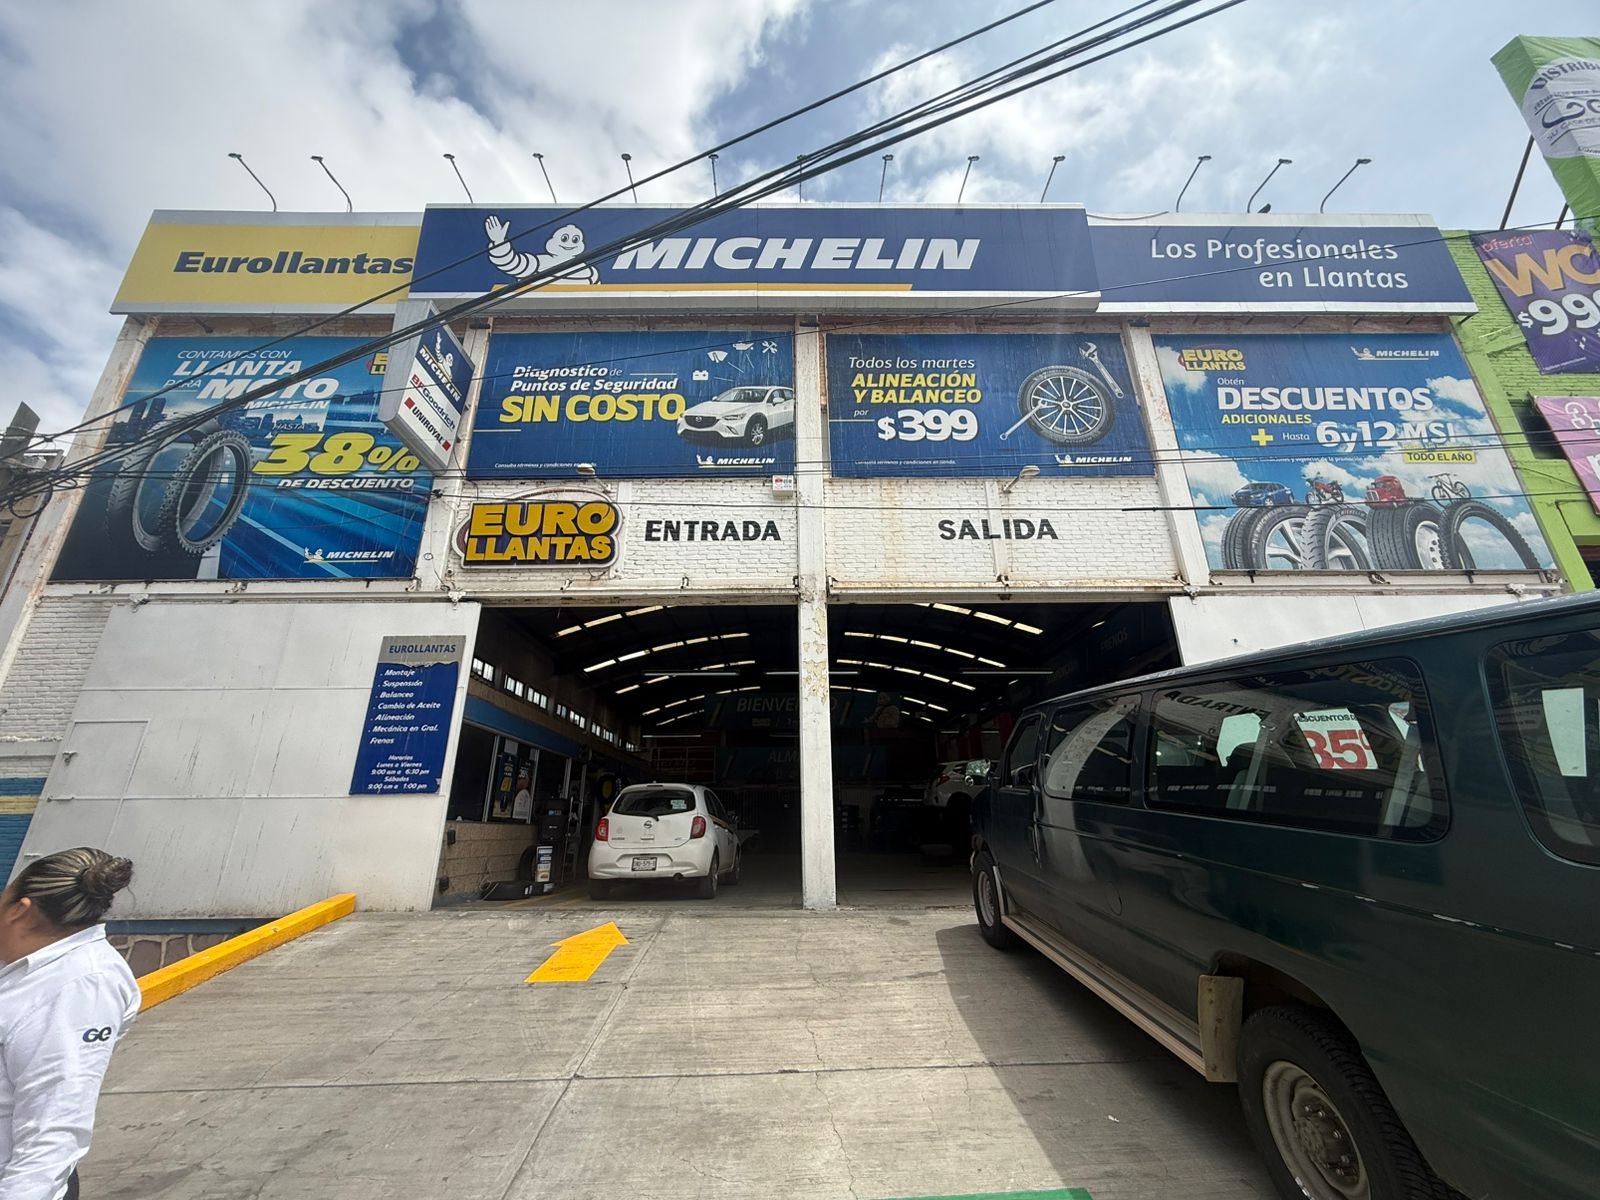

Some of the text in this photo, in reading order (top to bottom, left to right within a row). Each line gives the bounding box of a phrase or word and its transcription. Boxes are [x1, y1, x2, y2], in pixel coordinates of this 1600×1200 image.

[611, 237, 981, 270] MICHELIN
[1151, 238, 1399, 264] Los Profesionales
[172, 250, 414, 275] Eurollantas
[1259, 266, 1409, 288] en Llantas
[1517, 289, 1600, 336] $99
[260, 350, 293, 359] CON
[1182, 349, 1244, 361] EURO
[173, 360, 302, 376] LLANTA
[848, 357, 975, 369] Todos los martes
[1185, 361, 1247, 371] LLANTAS
[419, 347, 461, 402] MICHELIN
[512, 364, 623, 380] Diagnostico de
[851, 369, 976, 388] ALINEACIÓN
[510, 378, 679, 393] Puntos de Seguridad
[1217, 377, 1245, 386] Obtén
[411, 373, 456, 430] BFGoodrich
[853, 389, 982, 403] Y BALANCEO
[1217, 387, 1434, 411] DESCUENTOS
[244, 400, 328, 410] MICHELIN
[499, 393, 687, 423] SIN COSTO
[854, 409, 869, 417] por
[411, 406, 444, 445] UNIROYAL
[877, 409, 979, 442] $399
[1221, 414, 1312, 424] ADICIONALES
[1282, 431, 1310, 441] Hasta
[1402, 422, 1456, 443] MSI
[252, 432, 420, 476] 38%
[717, 457, 776, 465] MICHELIN
[1407, 451, 1473, 461] TODO EL AÑO
[278, 478, 415, 489] DE DESCUENTO
[469, 503, 616, 535] EURO
[644, 520, 782, 541] ENTRADA
[938, 518, 1059, 540] SALIDA
[326, 550, 394, 559] MICHELIN
[465, 535, 613, 561] LLANTAS
[389, 644, 457, 654] EUROLLANTAS
[384, 669, 415, 677] Montaje
[382, 680, 423, 688] Suspensión
[377, 702, 405, 710] Cambio
[375, 713, 415, 721] Alineación
